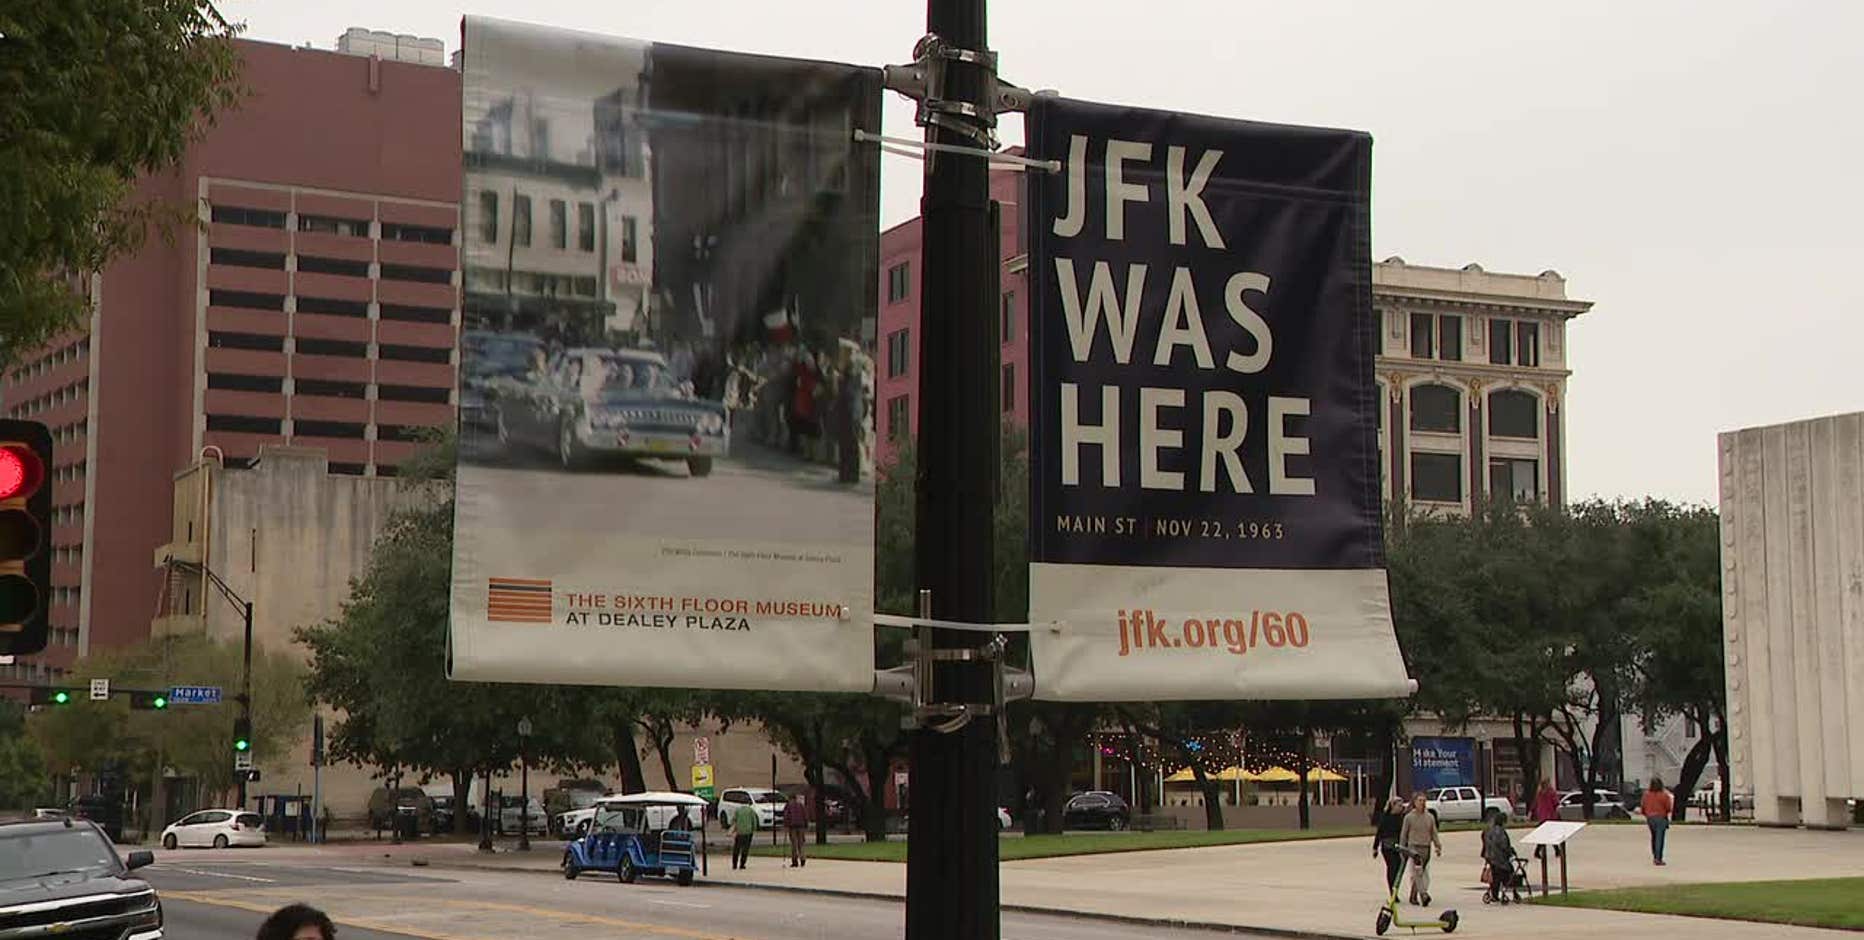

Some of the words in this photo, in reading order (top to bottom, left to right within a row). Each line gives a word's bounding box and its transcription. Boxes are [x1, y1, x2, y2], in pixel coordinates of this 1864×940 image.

[1052, 133, 1227, 250] JFK
[1054, 256, 1274, 375] WAS
[1060, 382, 1317, 496] HERE
[1056, 515, 1106, 533] MAIN
[1115, 517, 1137, 535] ST
[1156, 518, 1192, 537] NOV
[1200, 520, 1231, 540] 22,
[1237, 522, 1284, 540] 1963
[565, 593, 608, 609] THE
[613, 595, 675, 612] SIXTH
[680, 597, 749, 615] FLOOR
[755, 600, 842, 618] MUSEUM
[565, 611, 590, 626] AT
[598, 613, 678, 628] DEALEY
[685, 615, 751, 632] PLAZA
[1118, 608, 1310, 657] jfk.org/60
[175, 687, 217, 699] Market
[1413, 758, 1459, 768] Statement
[1437, 748, 1457, 759] Your
